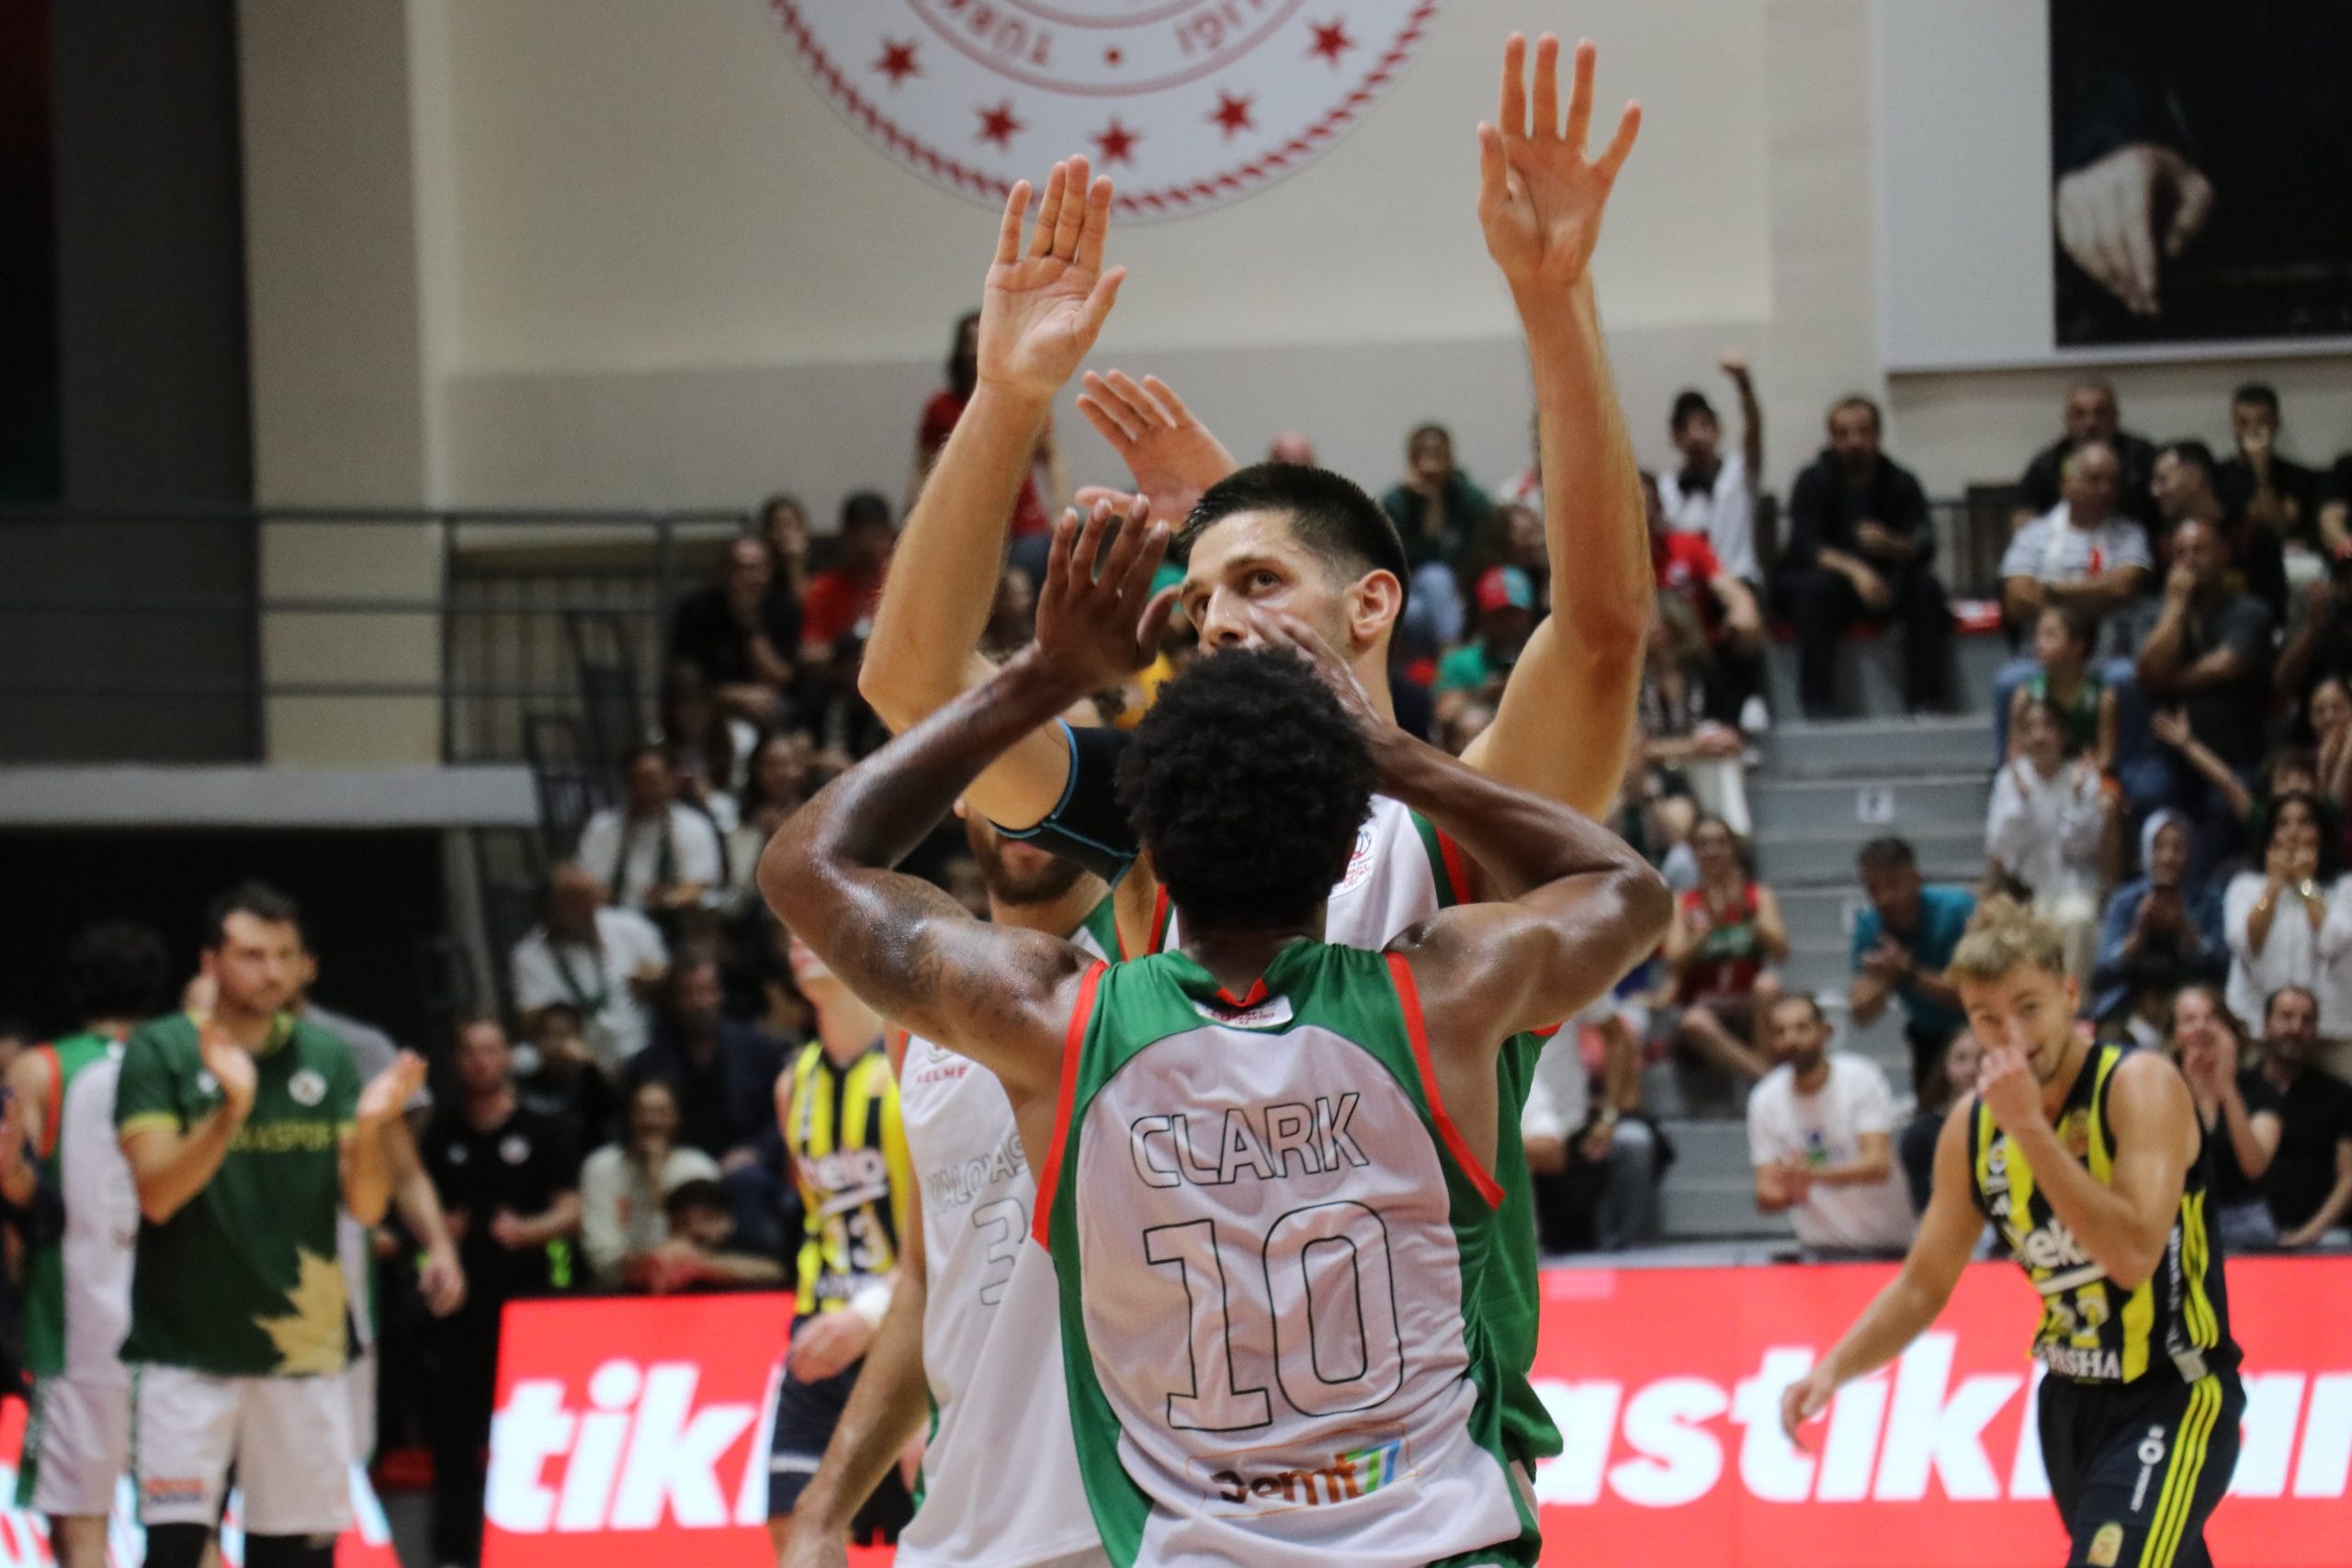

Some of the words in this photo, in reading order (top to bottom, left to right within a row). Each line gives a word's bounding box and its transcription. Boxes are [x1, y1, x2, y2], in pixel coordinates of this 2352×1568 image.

[1130, 1091, 1370, 1189] CLARK
[971, 1197, 1029, 1306] 3
[1143, 1200, 1405, 1432] 10
